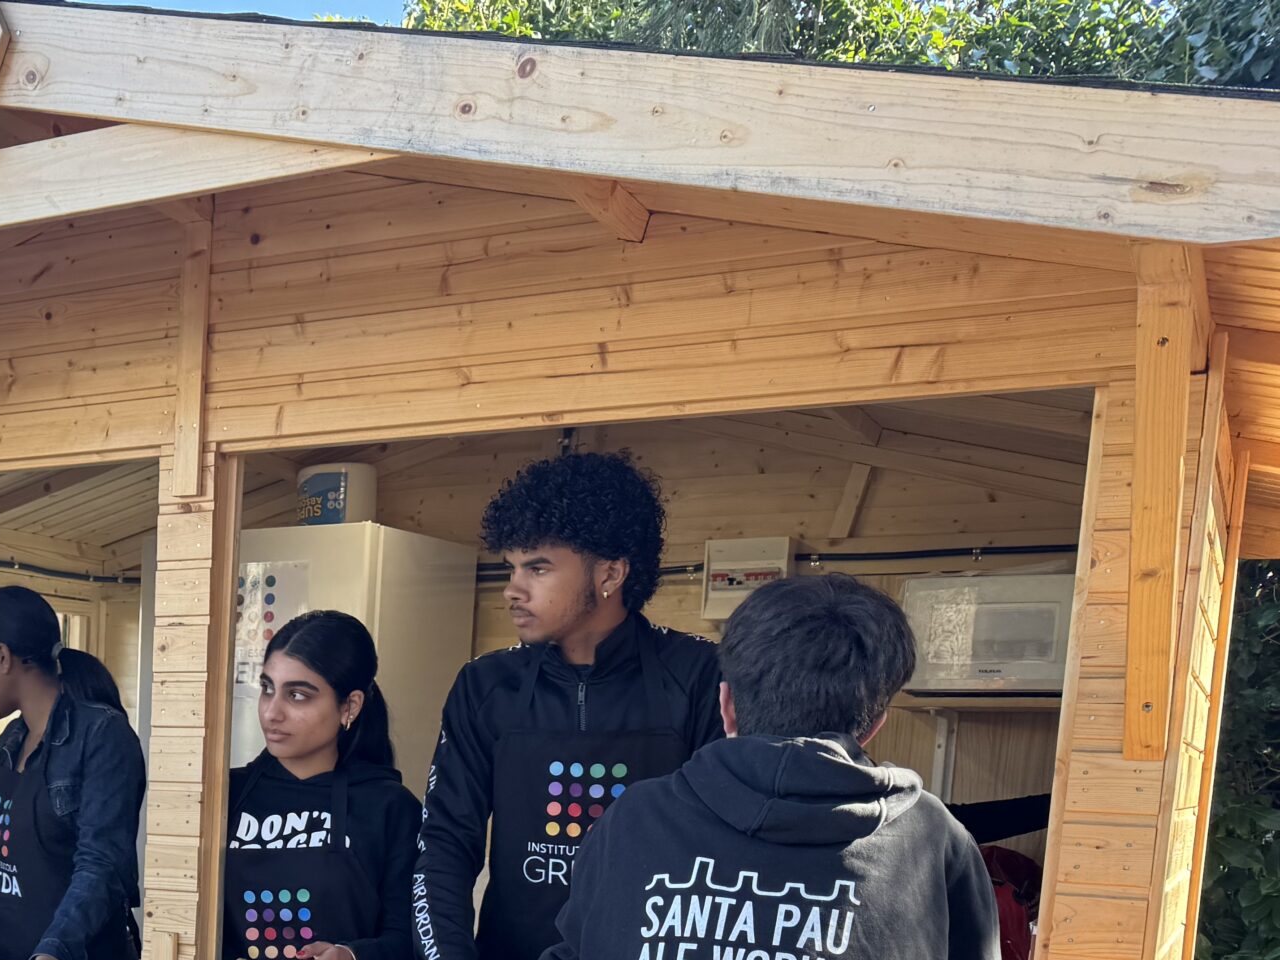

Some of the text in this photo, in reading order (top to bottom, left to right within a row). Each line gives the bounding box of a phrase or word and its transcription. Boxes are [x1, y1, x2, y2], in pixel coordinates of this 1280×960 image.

[523, 855, 574, 886] GR
[640, 894, 855, 955] SANTA PAU
